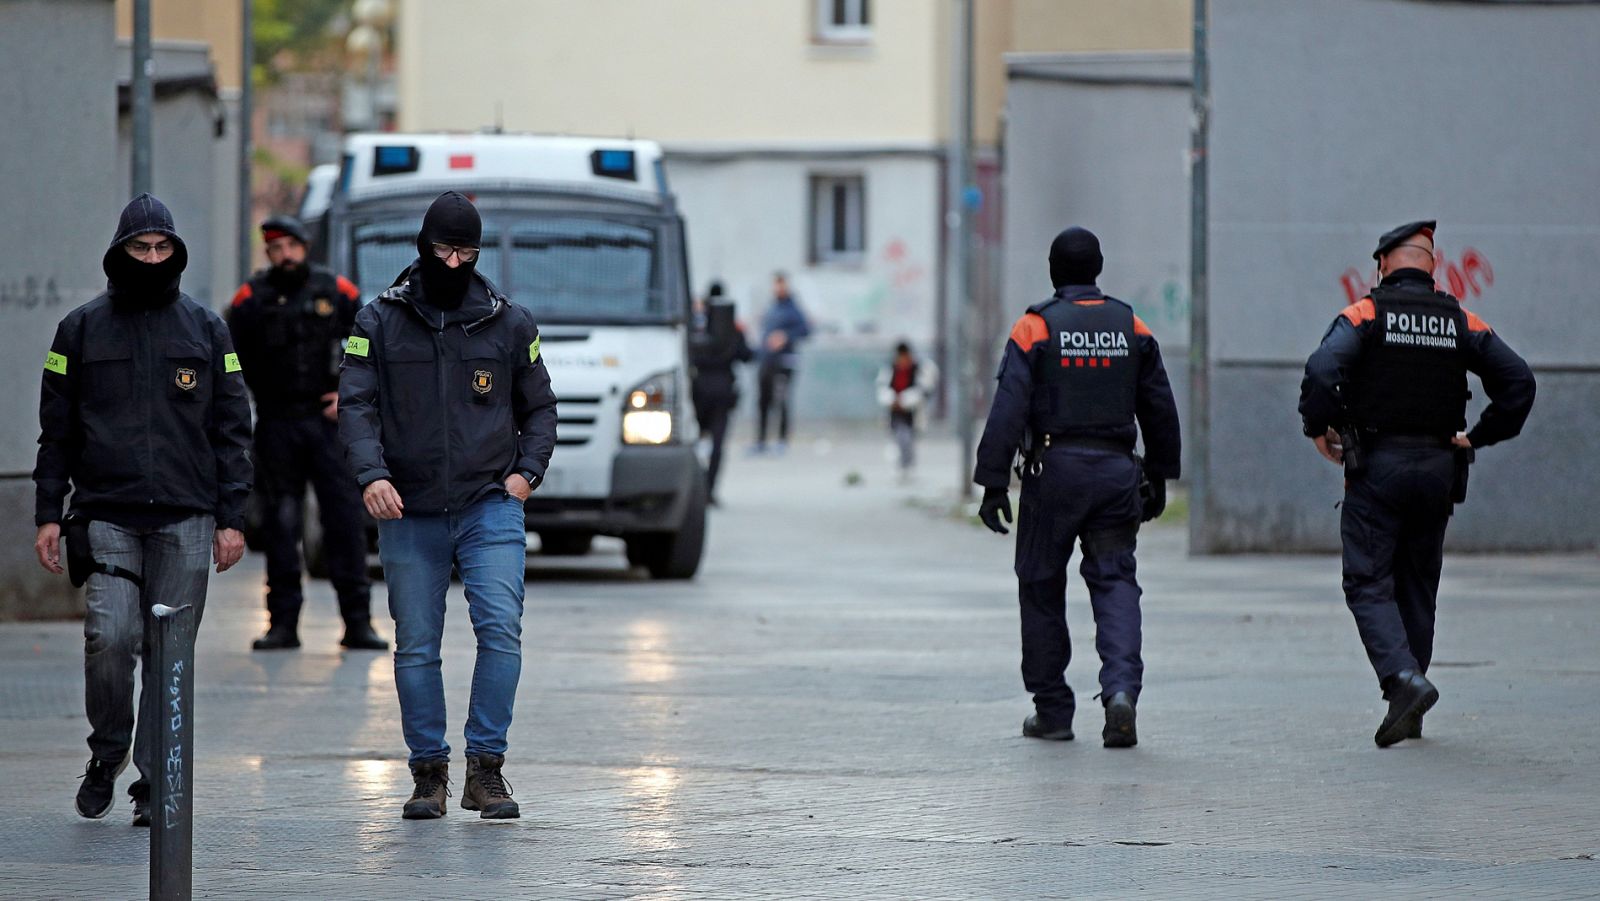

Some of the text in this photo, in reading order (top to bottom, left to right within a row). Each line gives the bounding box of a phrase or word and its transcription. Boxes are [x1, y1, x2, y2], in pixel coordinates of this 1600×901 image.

[1386, 312, 1457, 337] POLICIA
[1060, 331, 1128, 348] POLICIA
[1385, 331, 1457, 349] MOSSOS D'ESQUADRA
[1061, 348, 1090, 357] mossos
